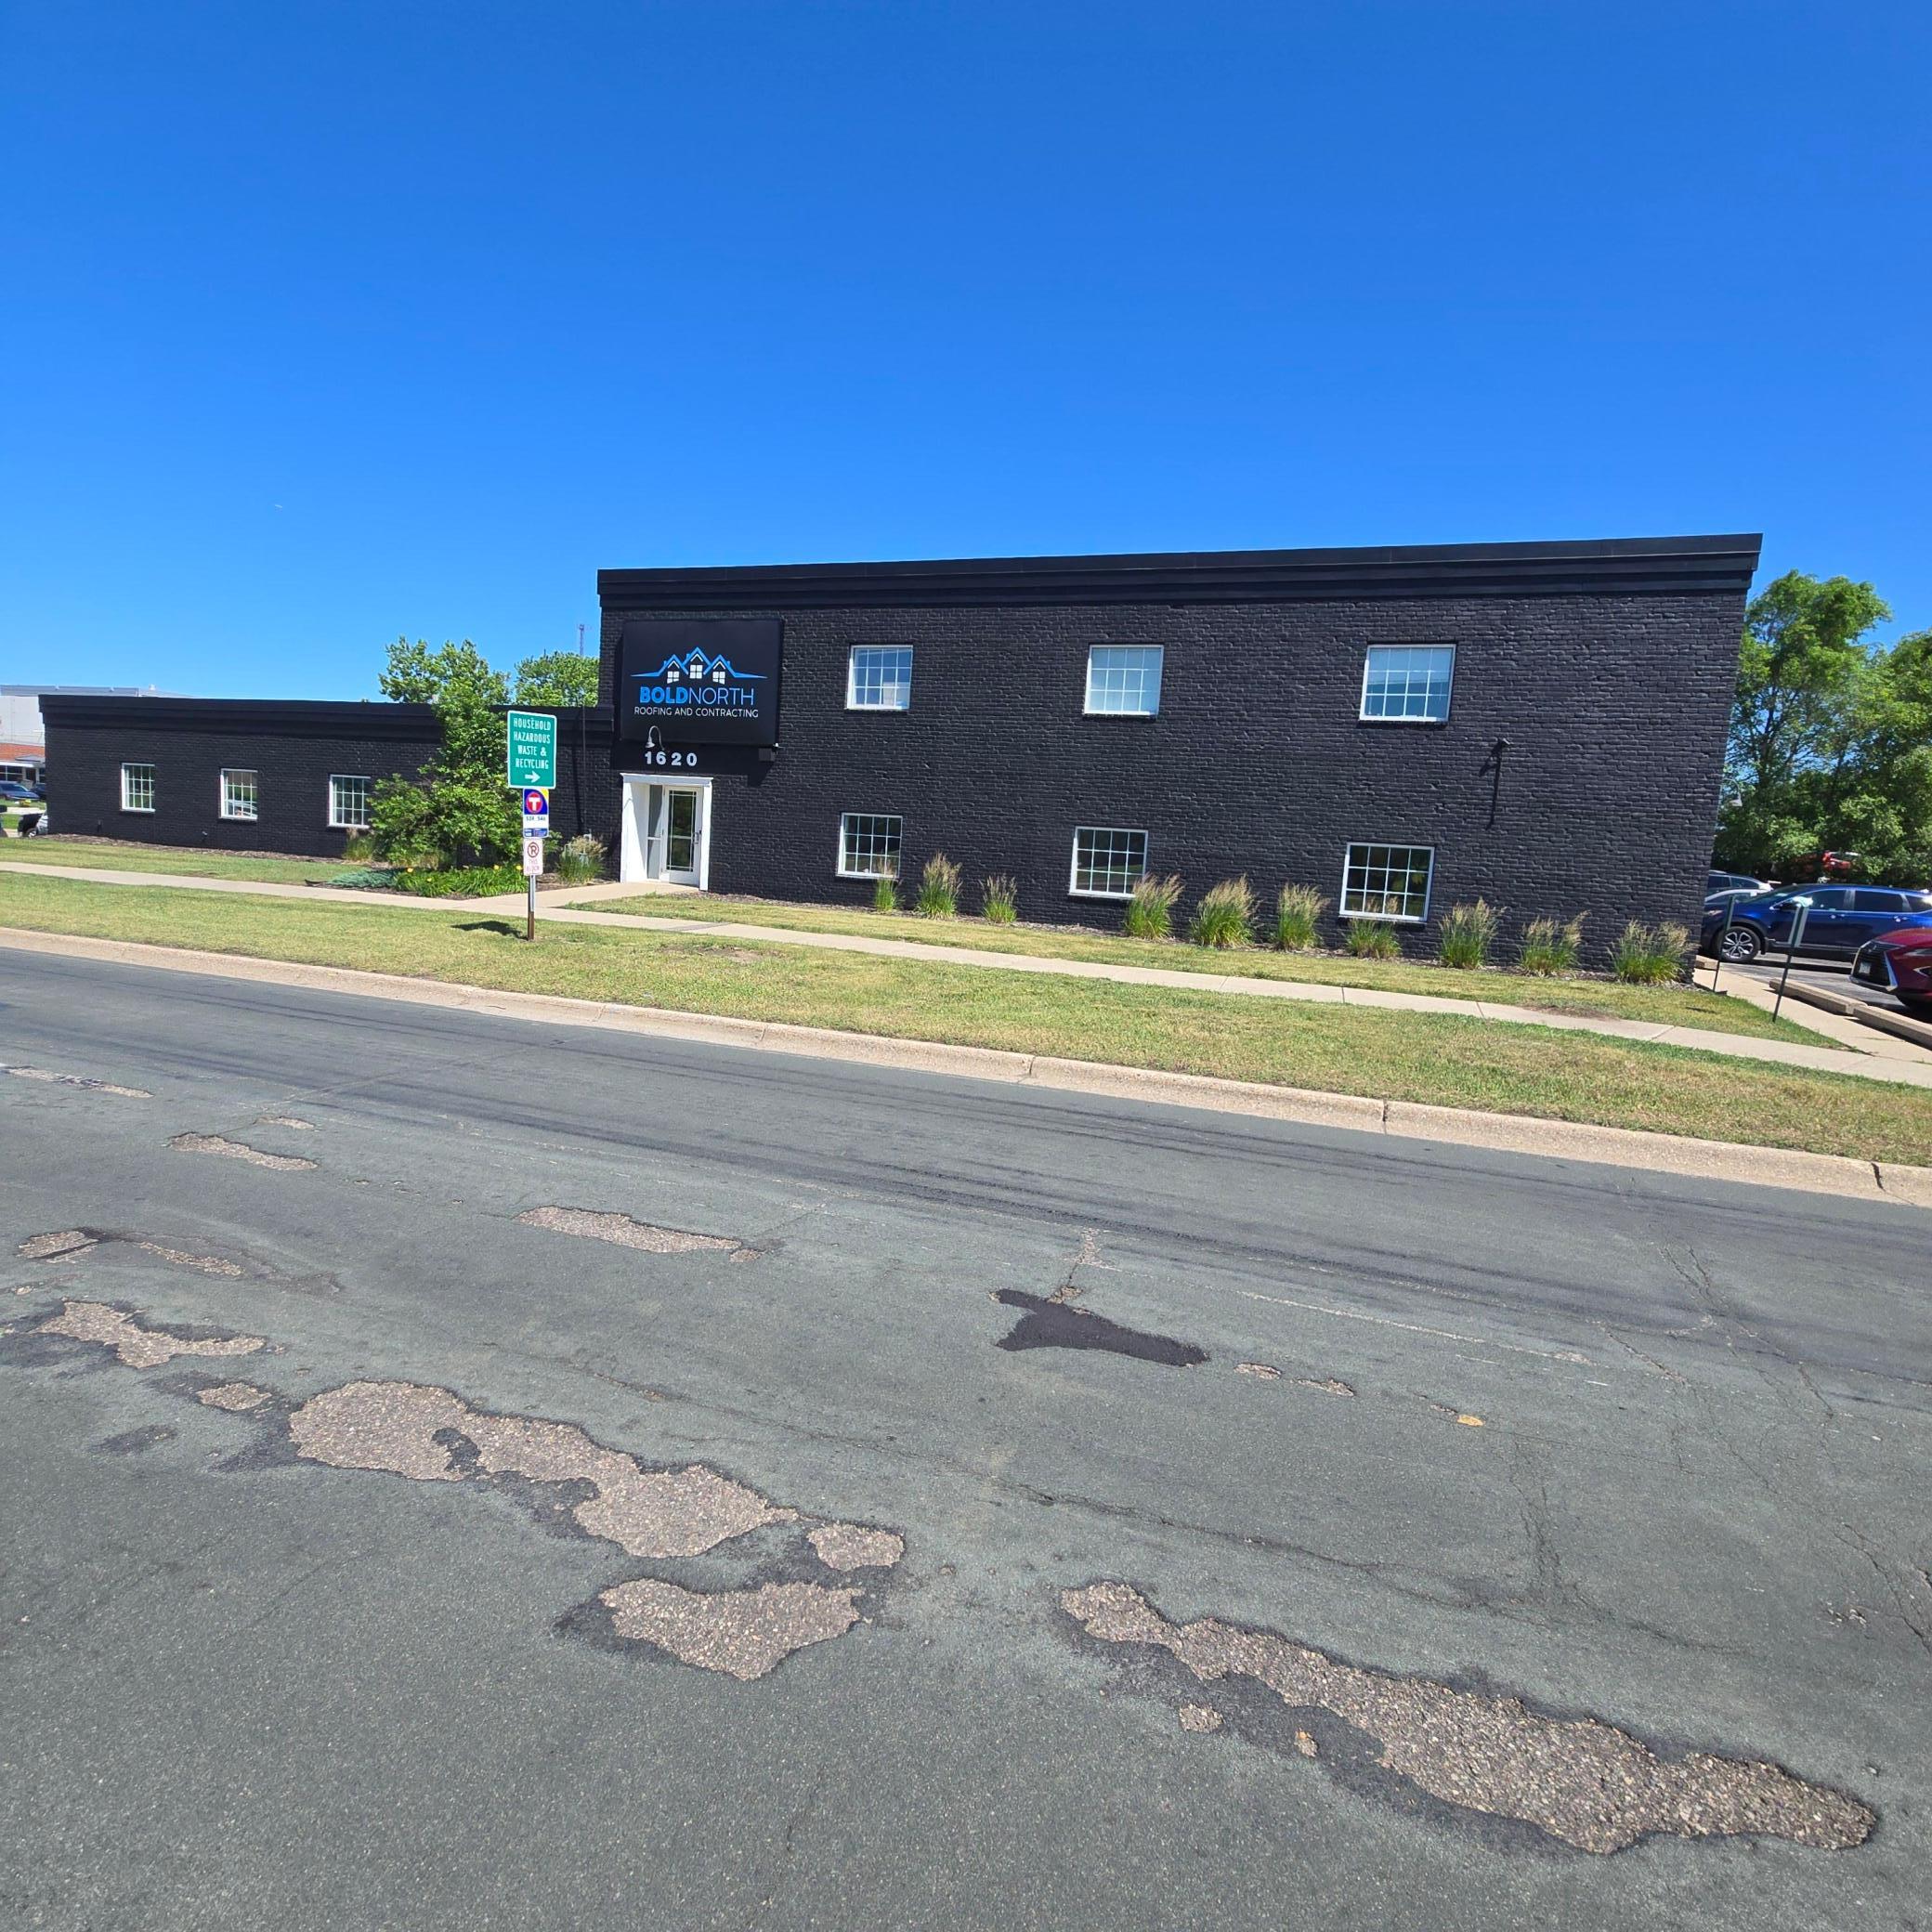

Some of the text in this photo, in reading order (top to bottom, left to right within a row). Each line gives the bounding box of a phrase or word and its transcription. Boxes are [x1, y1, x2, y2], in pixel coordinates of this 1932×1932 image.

[639, 686, 754, 706] BOLDNORTH
[634, 707, 759, 718] ROOFING AND CONTRACTING
[513, 717, 552, 731] HOUSEHOLD
[513, 731, 551, 744] HAZARDOUS
[517, 745, 547, 757] WASTE &
[515, 758, 549, 770] RECYCLING
[645, 751, 698, 766] 1620
